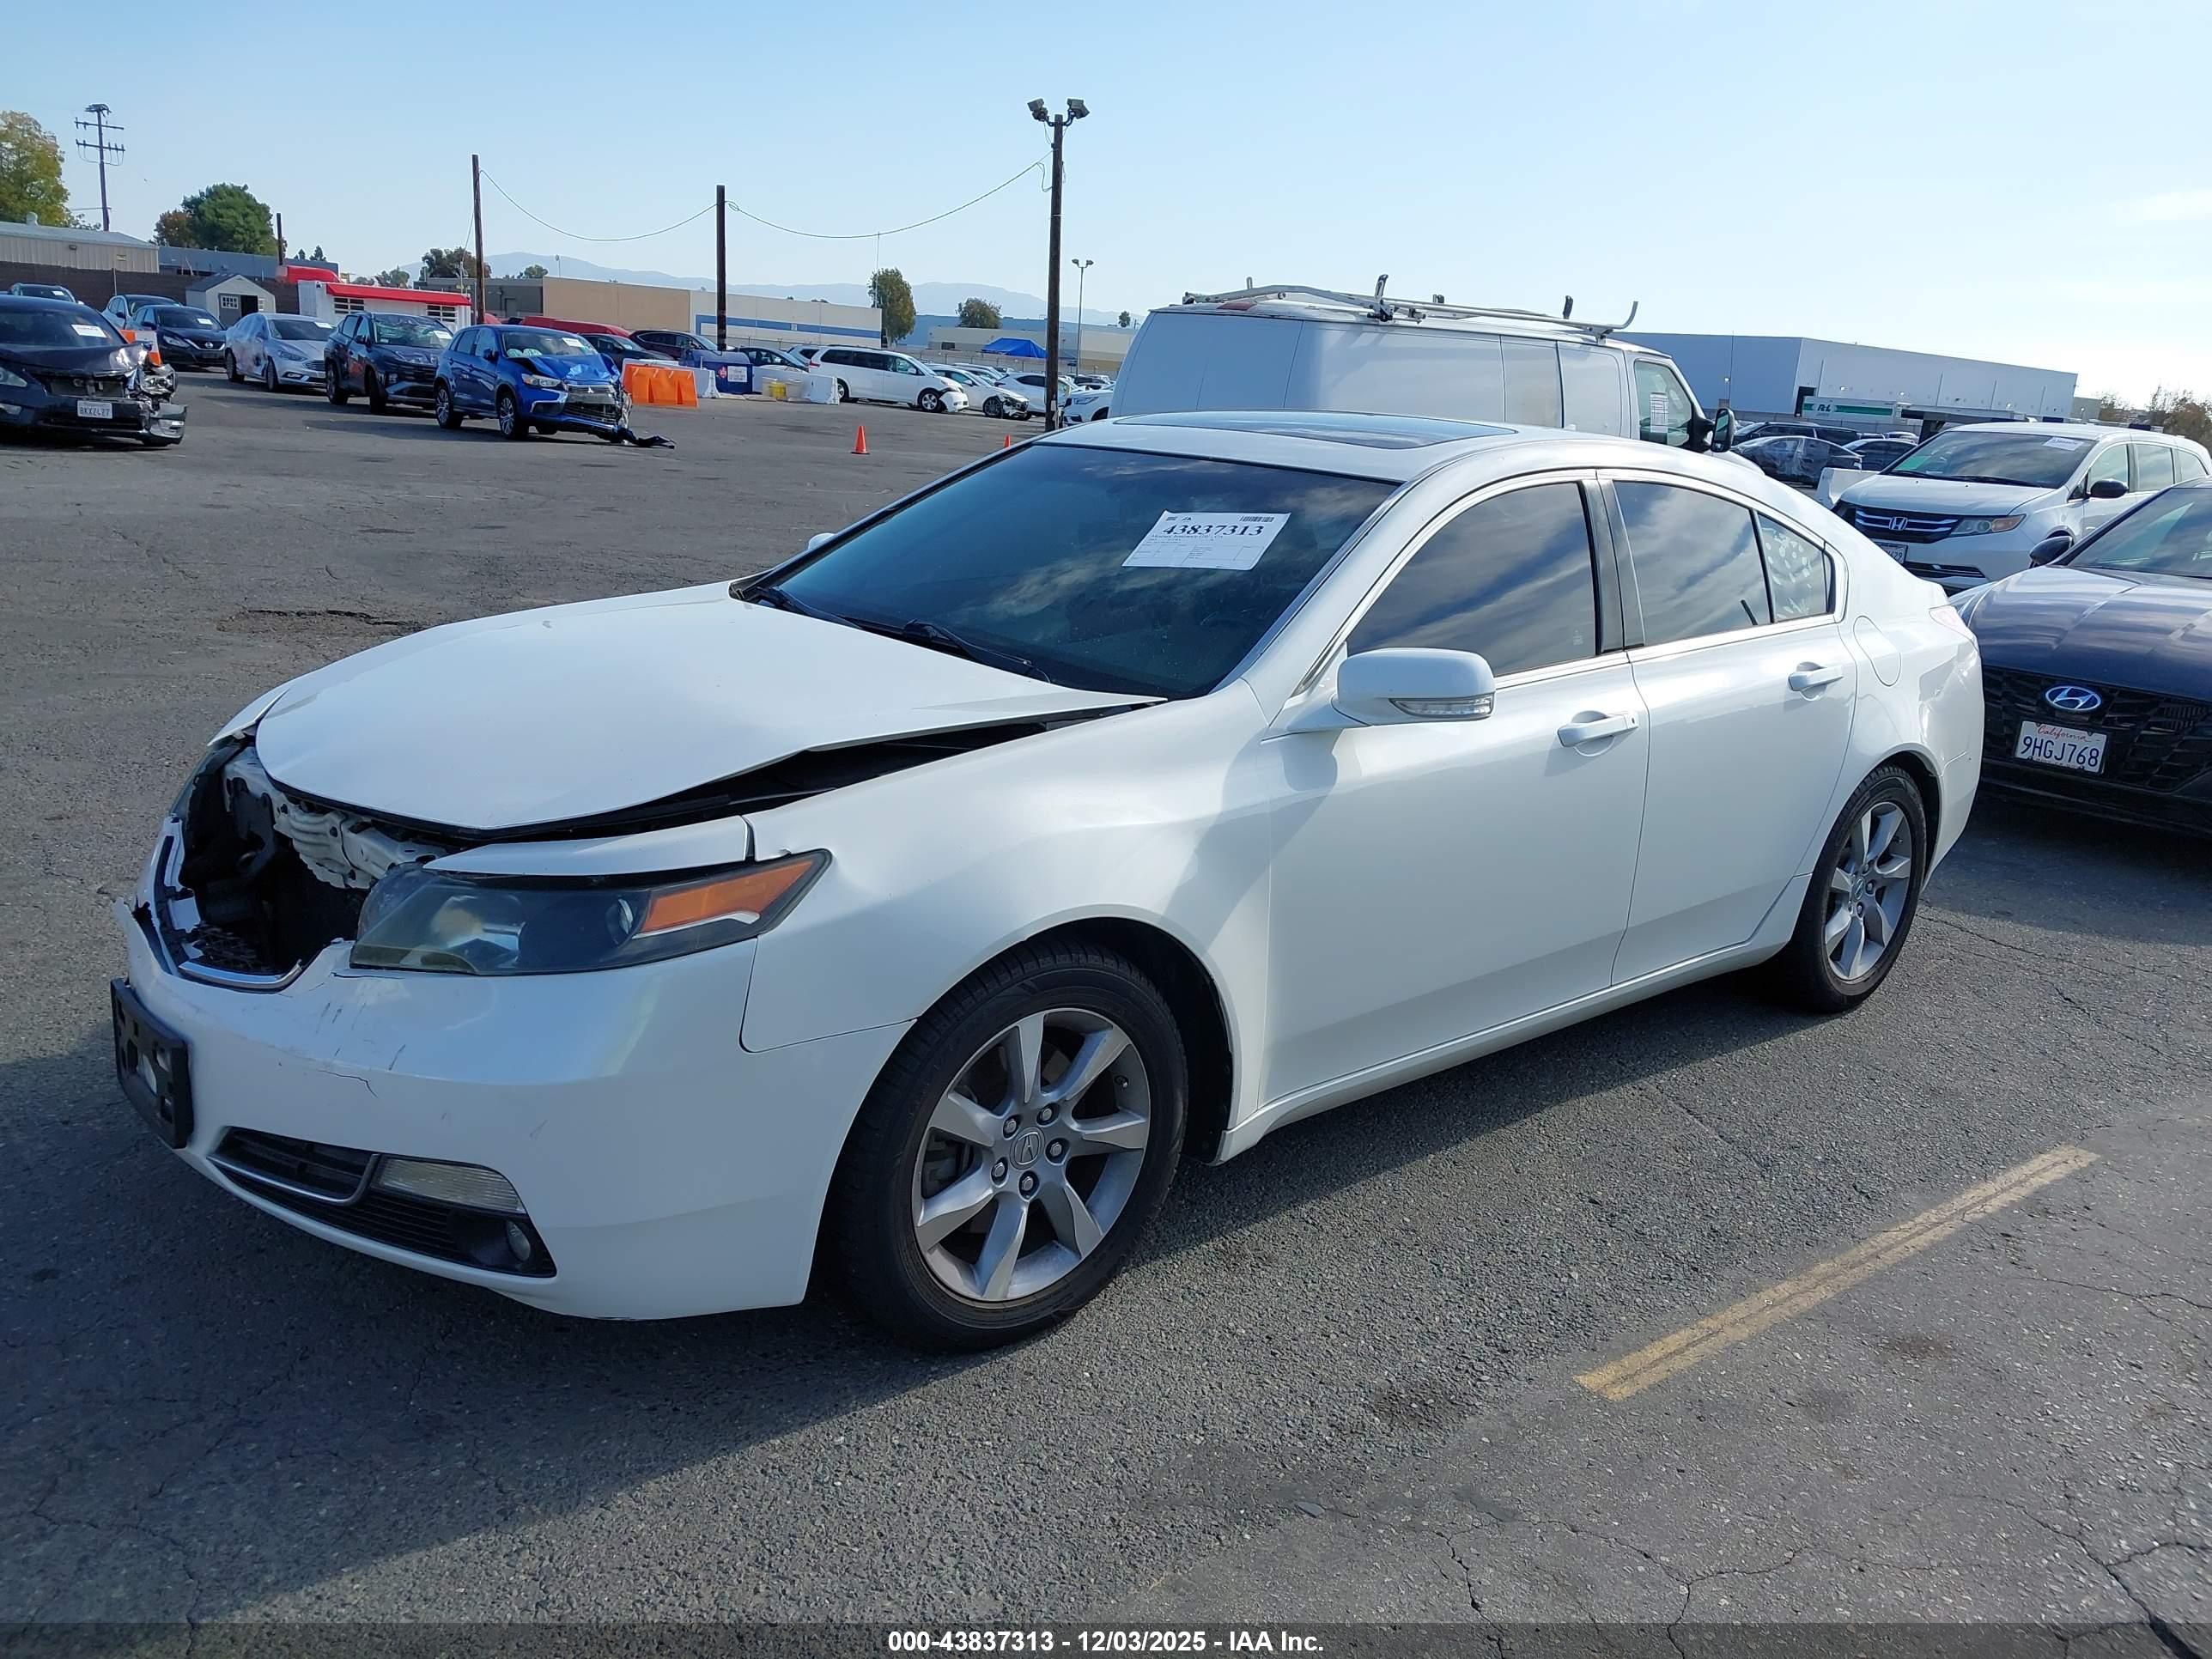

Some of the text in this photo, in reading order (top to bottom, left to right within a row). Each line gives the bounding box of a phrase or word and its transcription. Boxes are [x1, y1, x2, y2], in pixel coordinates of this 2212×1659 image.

[1163, 524, 1265, 536] 43837313
[2038, 725, 2092, 743] California
[2021, 735, 2100, 768] 9HGJ768
